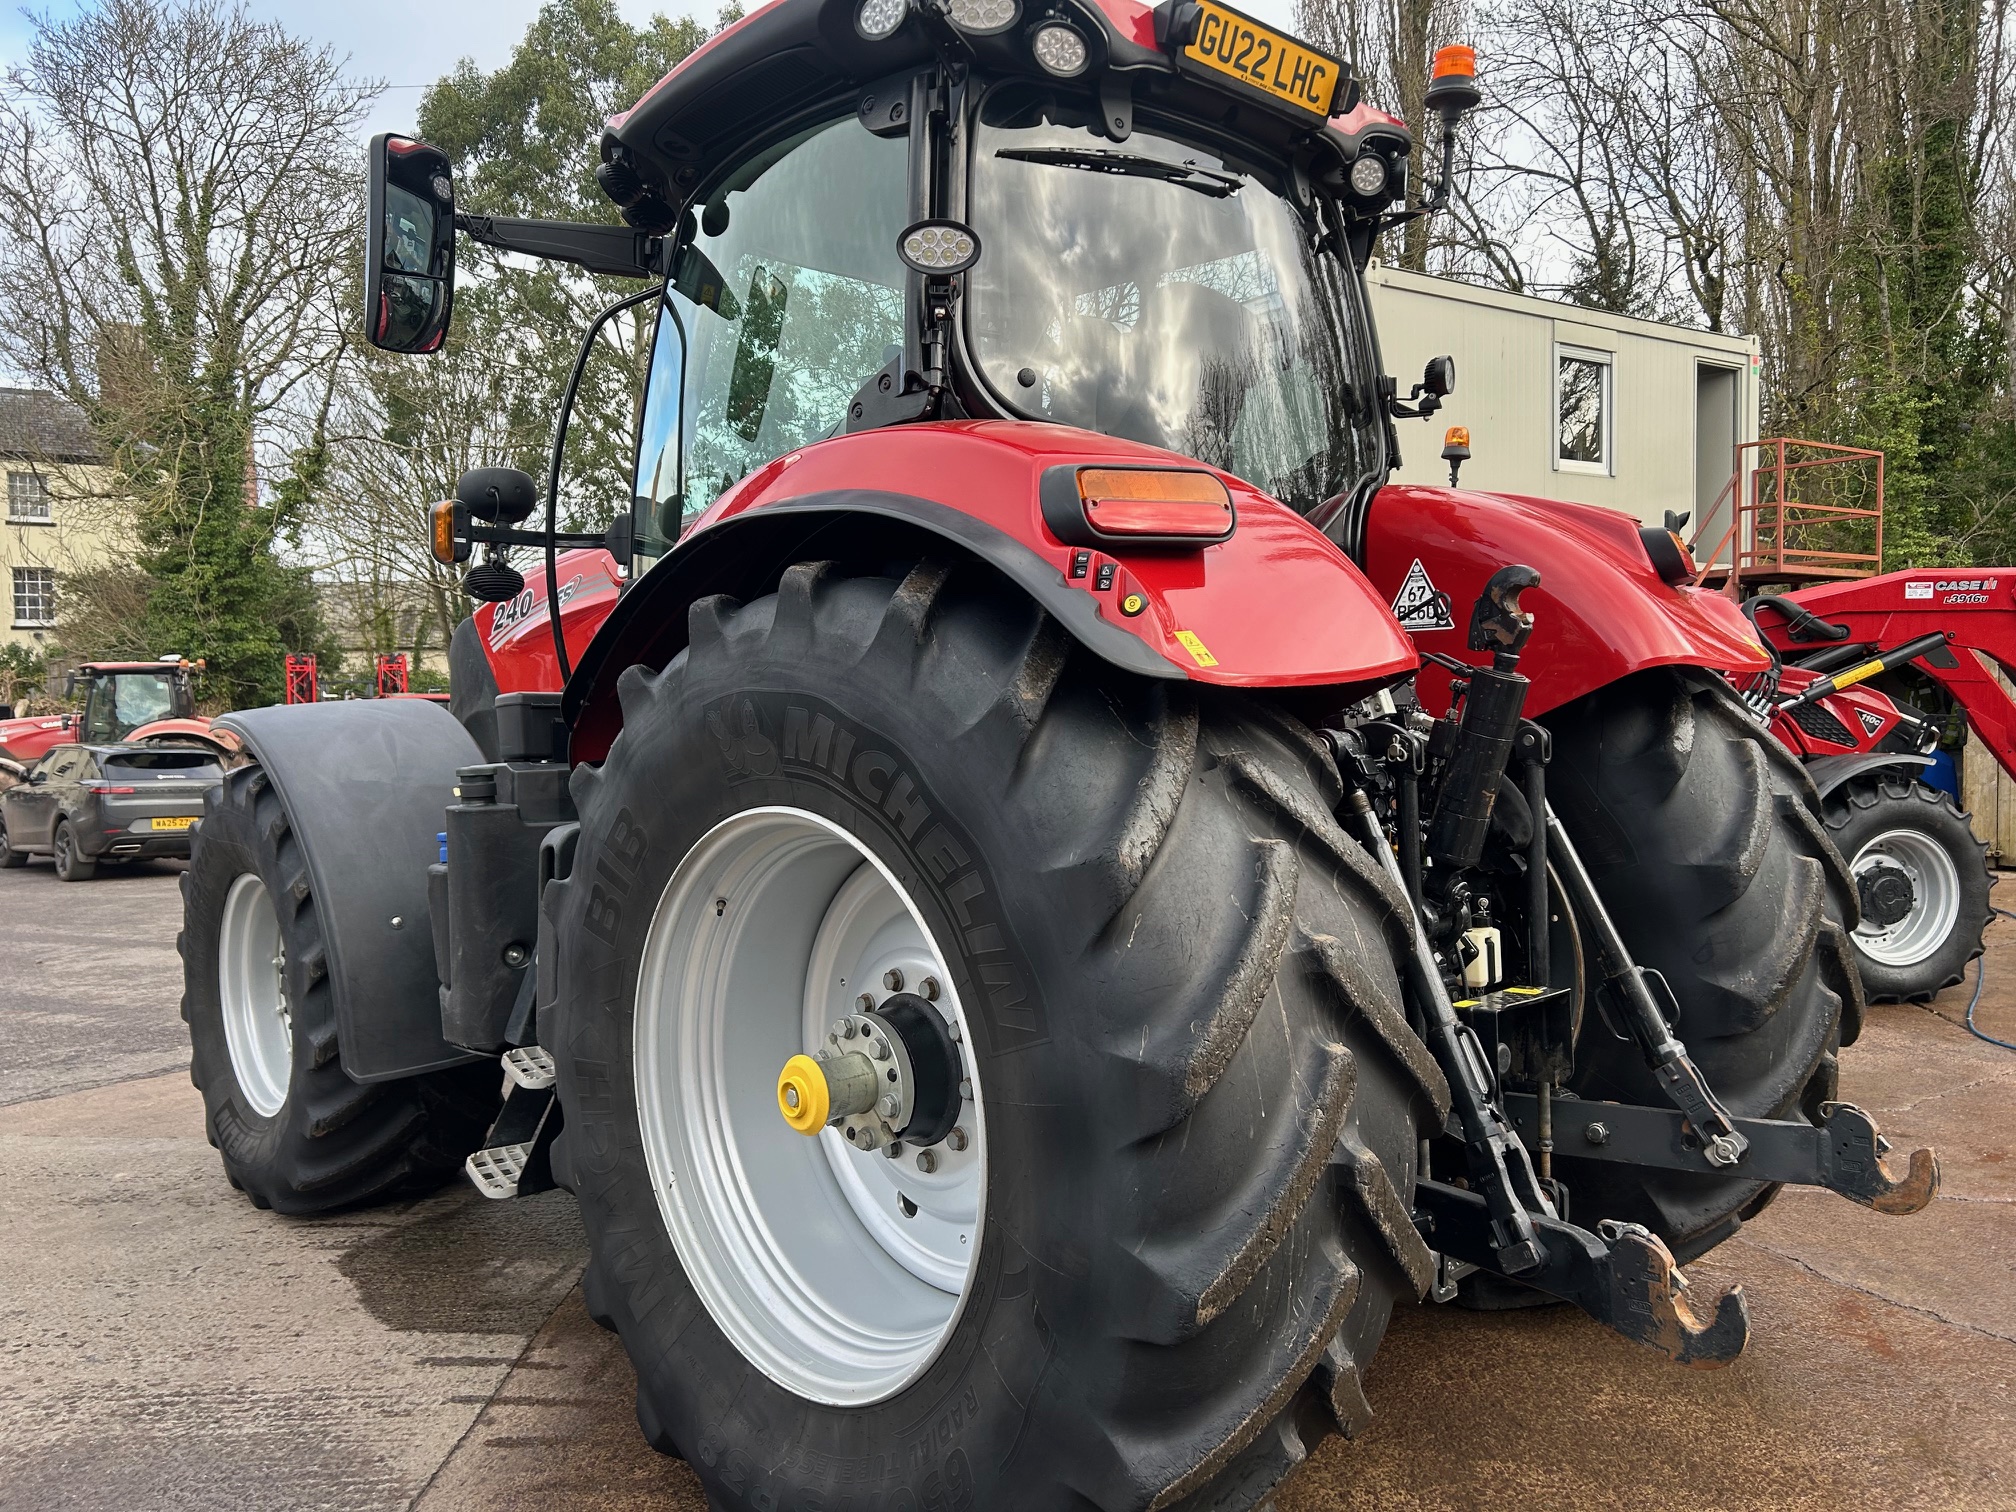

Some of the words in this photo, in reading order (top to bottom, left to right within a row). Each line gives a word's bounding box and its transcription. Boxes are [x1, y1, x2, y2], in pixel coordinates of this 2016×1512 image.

[1199, 12, 1272, 81] GU22
[1272, 48, 1326, 104] LHC
[1407, 585, 1426, 603] 67
[1934, 580, 1981, 591] CASE
[491, 589, 535, 634] 240
[156, 817, 177, 828] WA25
[783, 705, 1037, 1033] MICHELIN
[906, 1384, 980, 1472] RADIAL
[783, 1443, 902, 1485] TUBELESS
